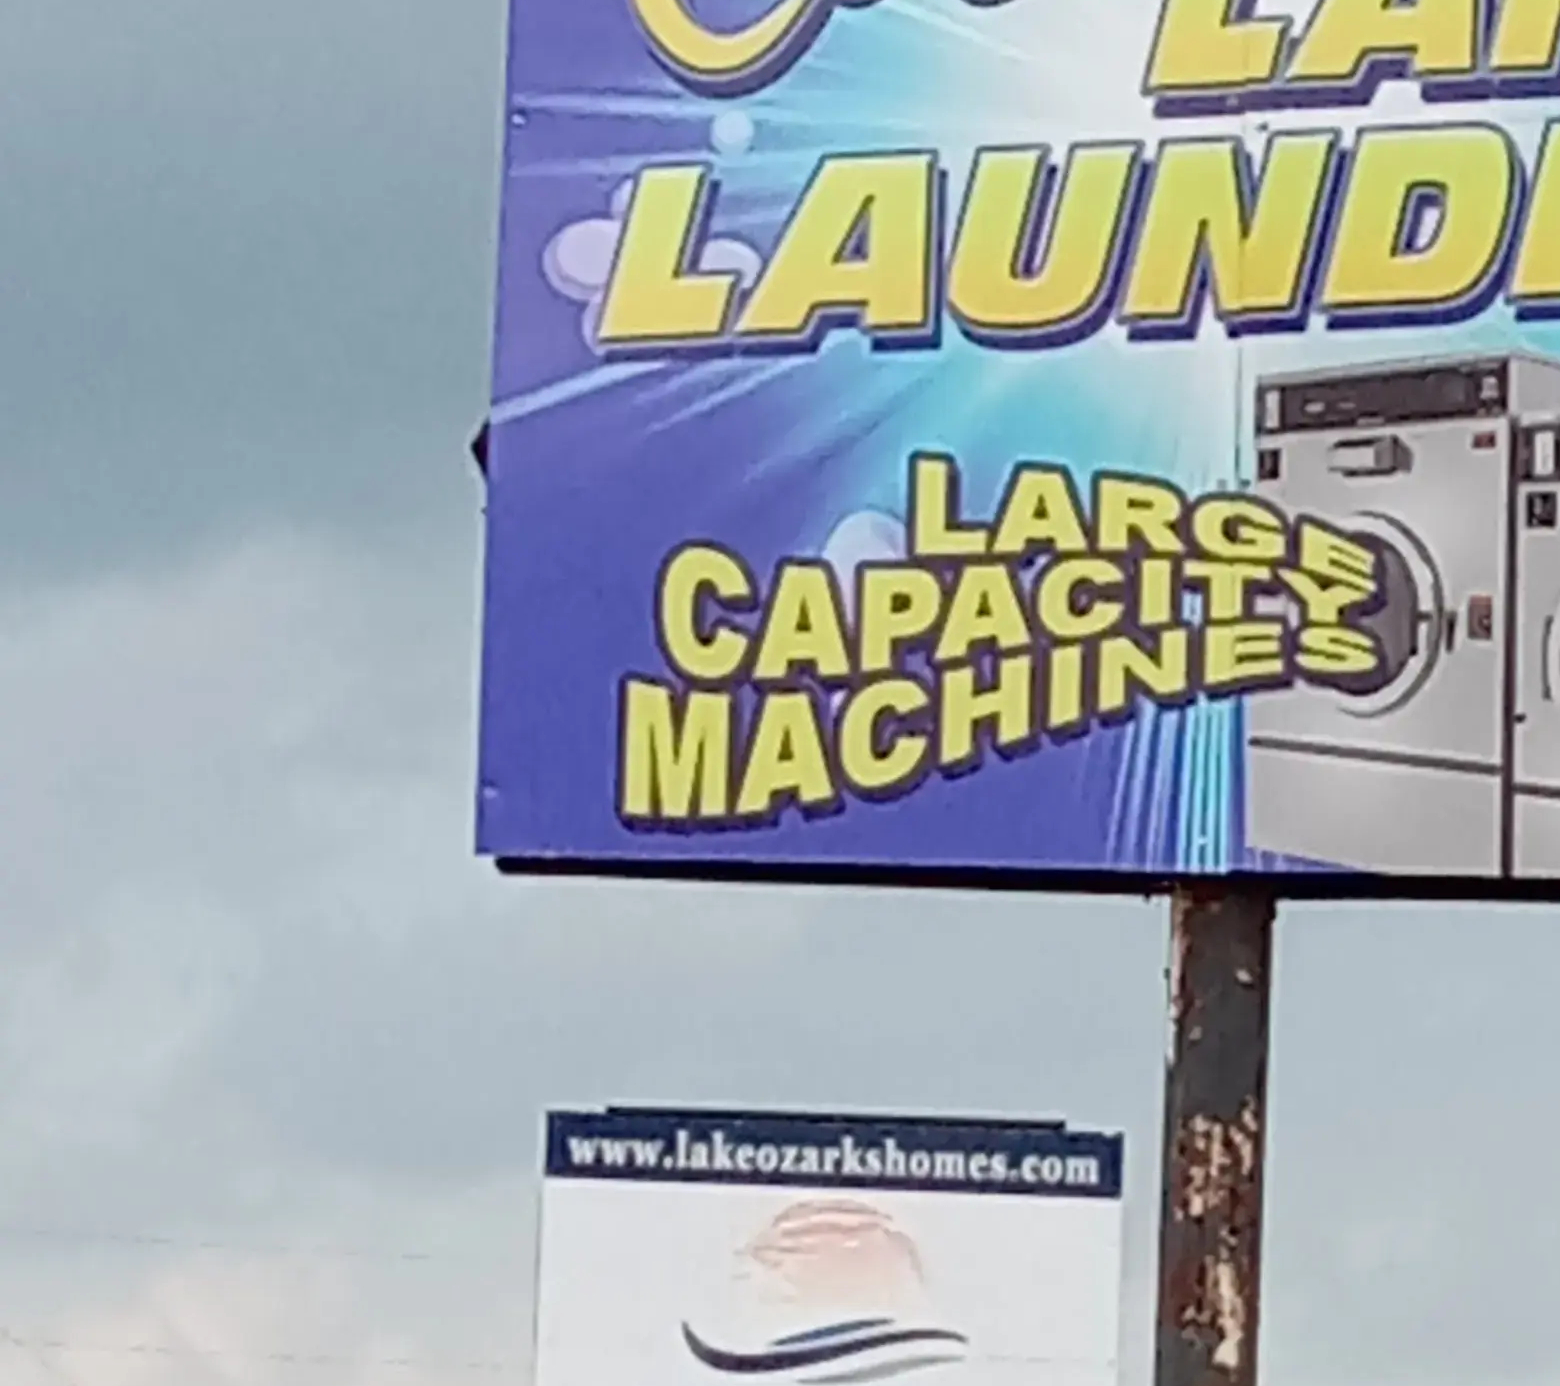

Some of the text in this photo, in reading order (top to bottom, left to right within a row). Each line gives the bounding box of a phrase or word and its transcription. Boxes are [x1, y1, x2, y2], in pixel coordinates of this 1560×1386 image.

[907, 454, 1379, 581] LARGE
[658, 543, 1379, 681] CAPACITY
[619, 617, 1380, 818] MACHINES
[567, 1128, 1100, 1186] www.lakeozarkshomes.com
